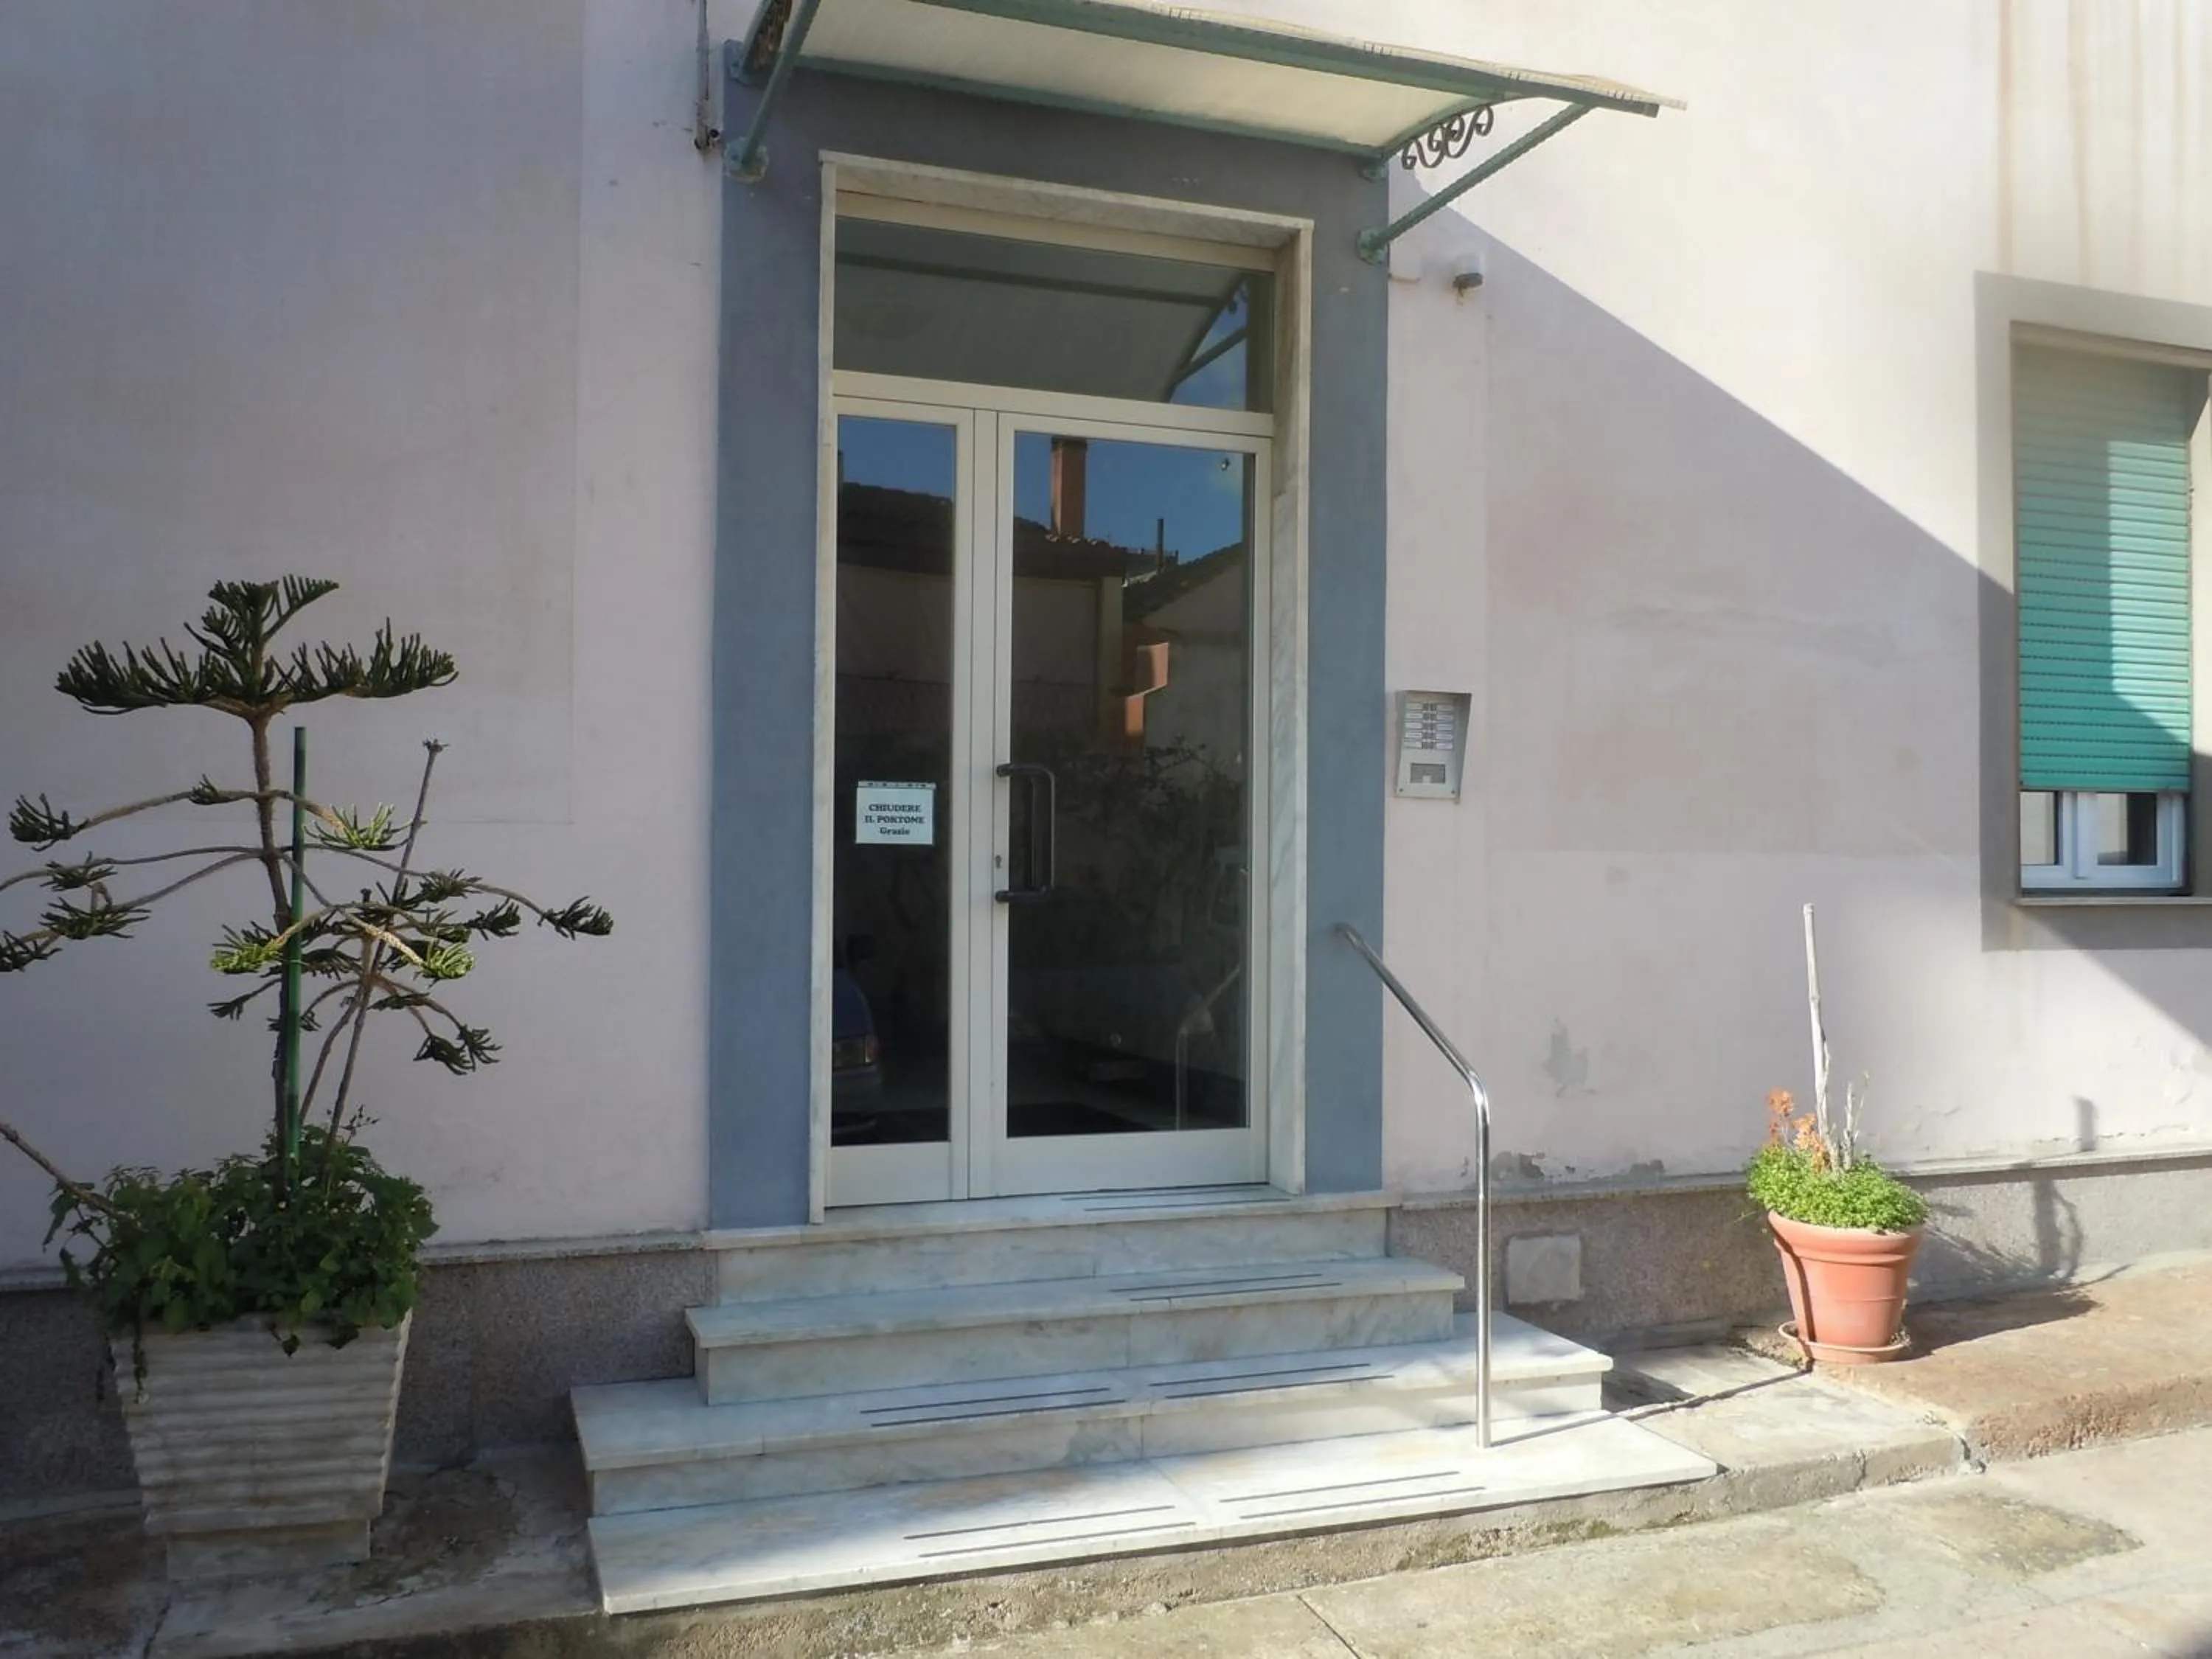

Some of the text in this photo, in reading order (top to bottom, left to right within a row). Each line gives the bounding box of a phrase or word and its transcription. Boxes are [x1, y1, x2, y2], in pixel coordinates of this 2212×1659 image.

[869, 804, 921, 813] CHIUDERE
[865, 815, 925, 824] IL PORTONE
[880, 827, 911, 835] Grazie
